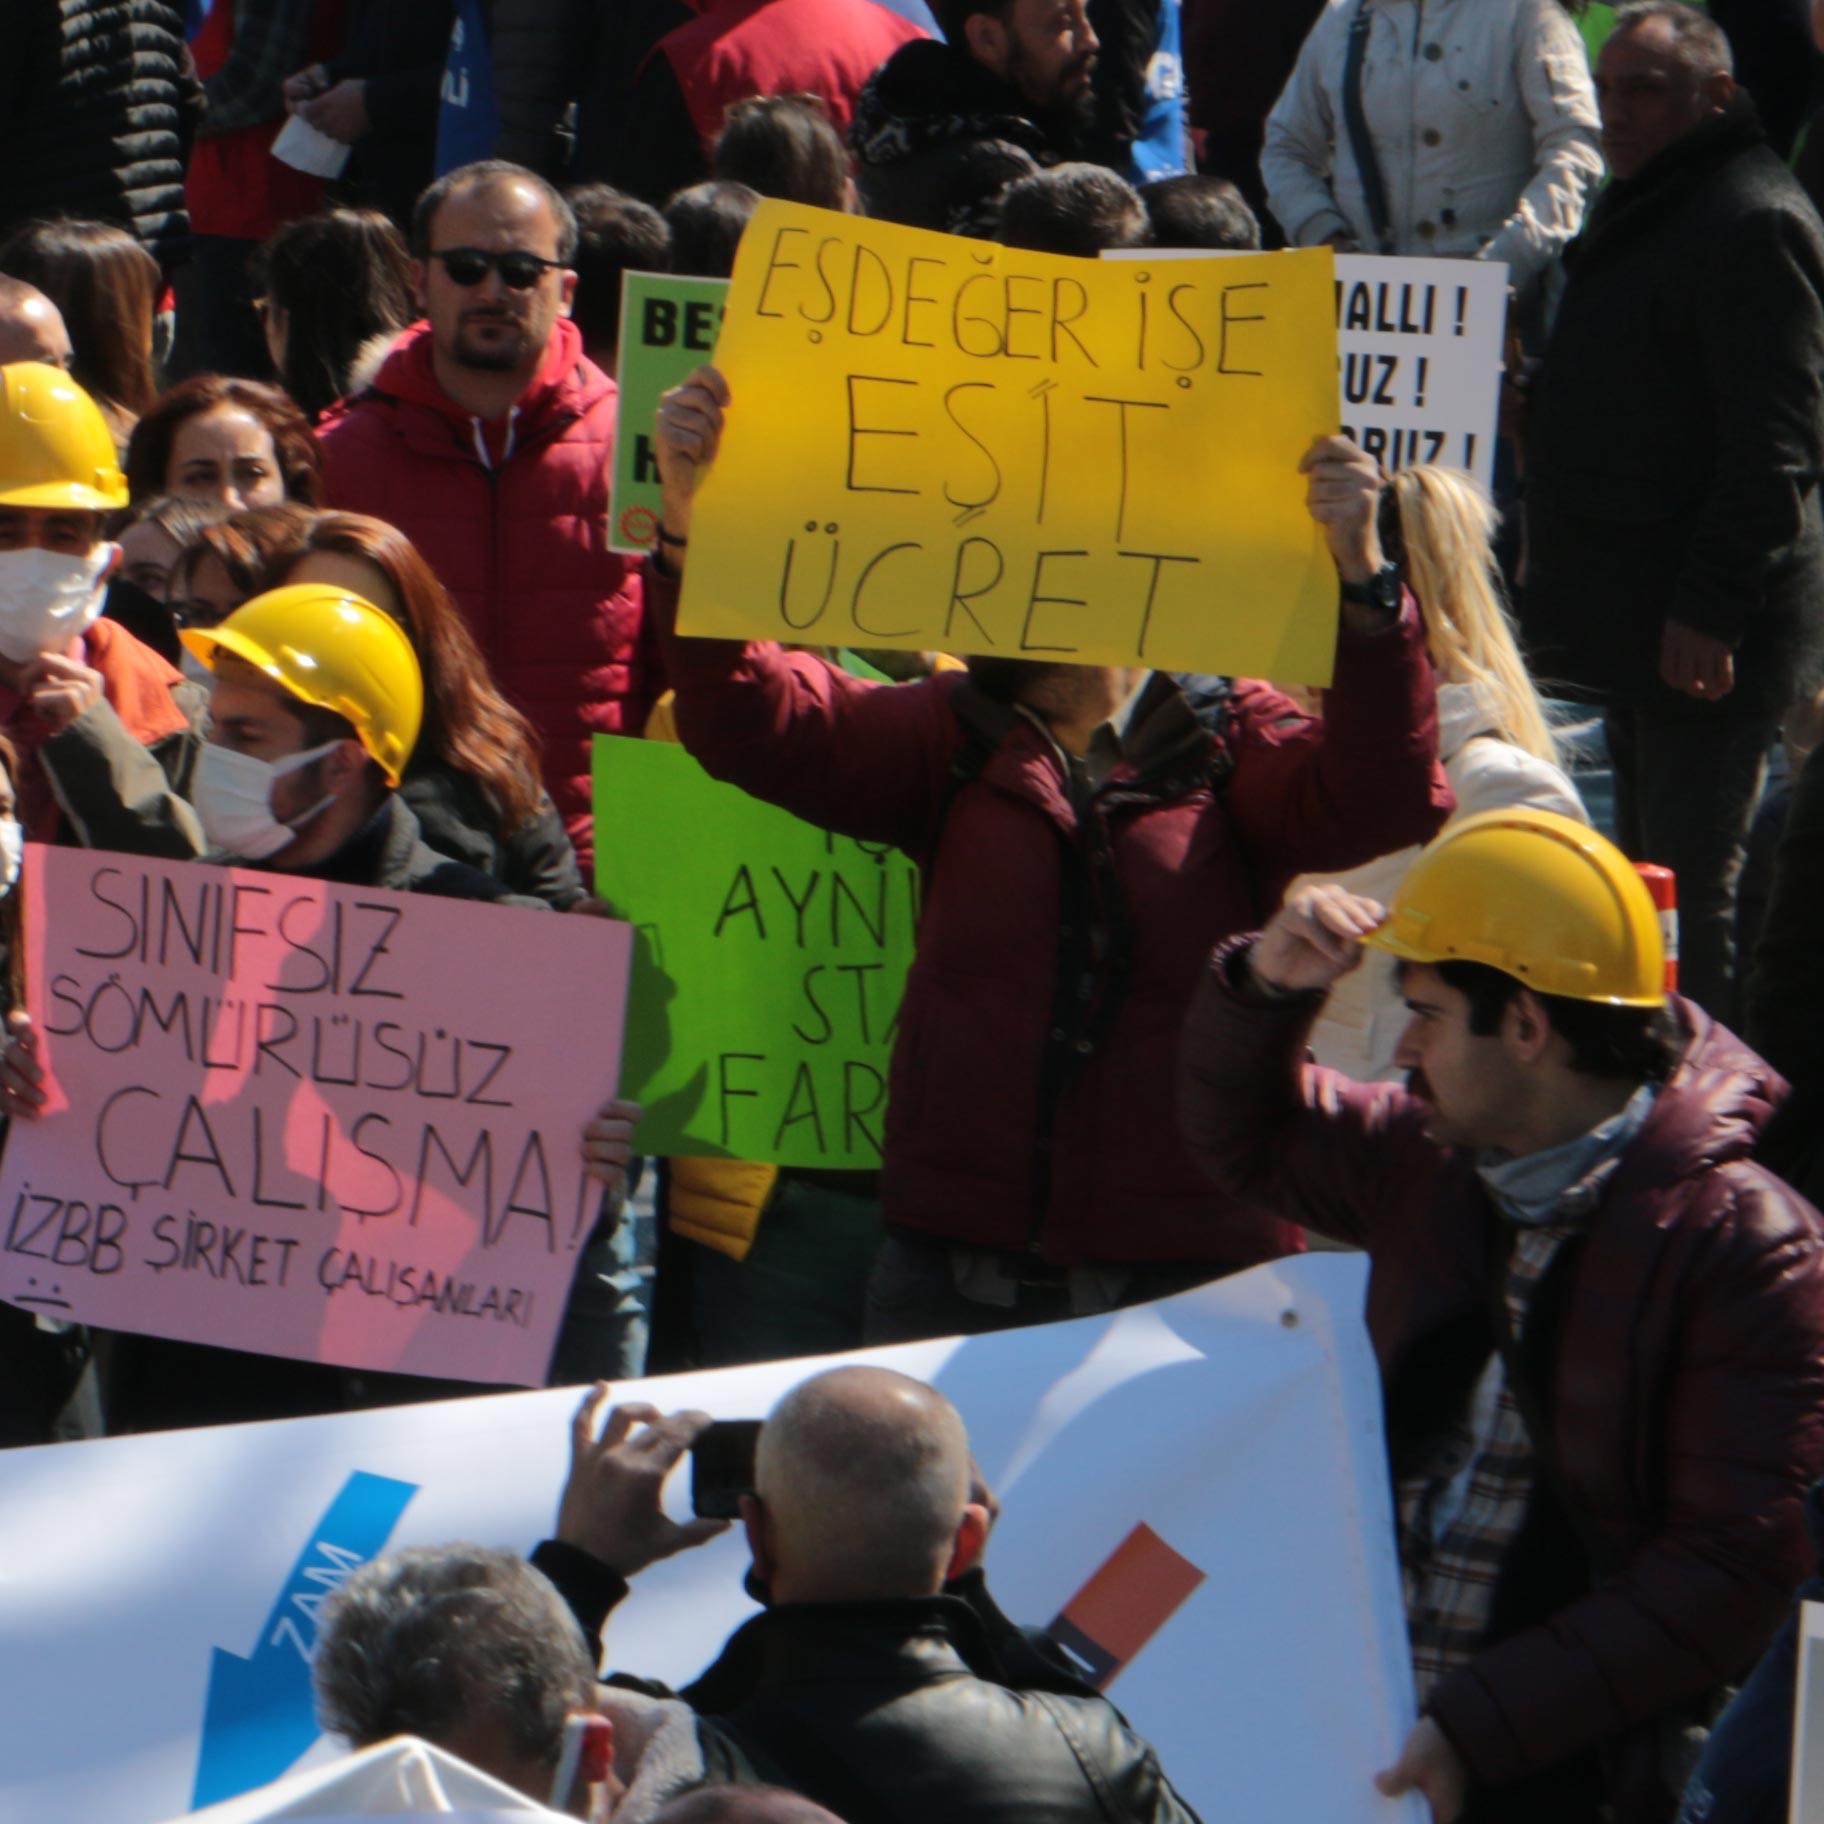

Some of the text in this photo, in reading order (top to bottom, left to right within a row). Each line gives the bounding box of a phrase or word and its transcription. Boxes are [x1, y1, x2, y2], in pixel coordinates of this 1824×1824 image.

[754, 224, 1270, 390] EŞDEĞER İŞE
[1342, 351, 1398, 407] UZ
[845, 372, 1172, 545] EŞİT
[778, 520, 1203, 659] ÜCRET
[74, 867, 406, 1001] SINIFSIZ
[713, 863, 919, 949] AYNI
[44, 972, 515, 1109] SÖMÜRÜSÜZ
[4, 1182, 129, 1276] İZBB
[143, 1208, 301, 1288] ŞİRKET
